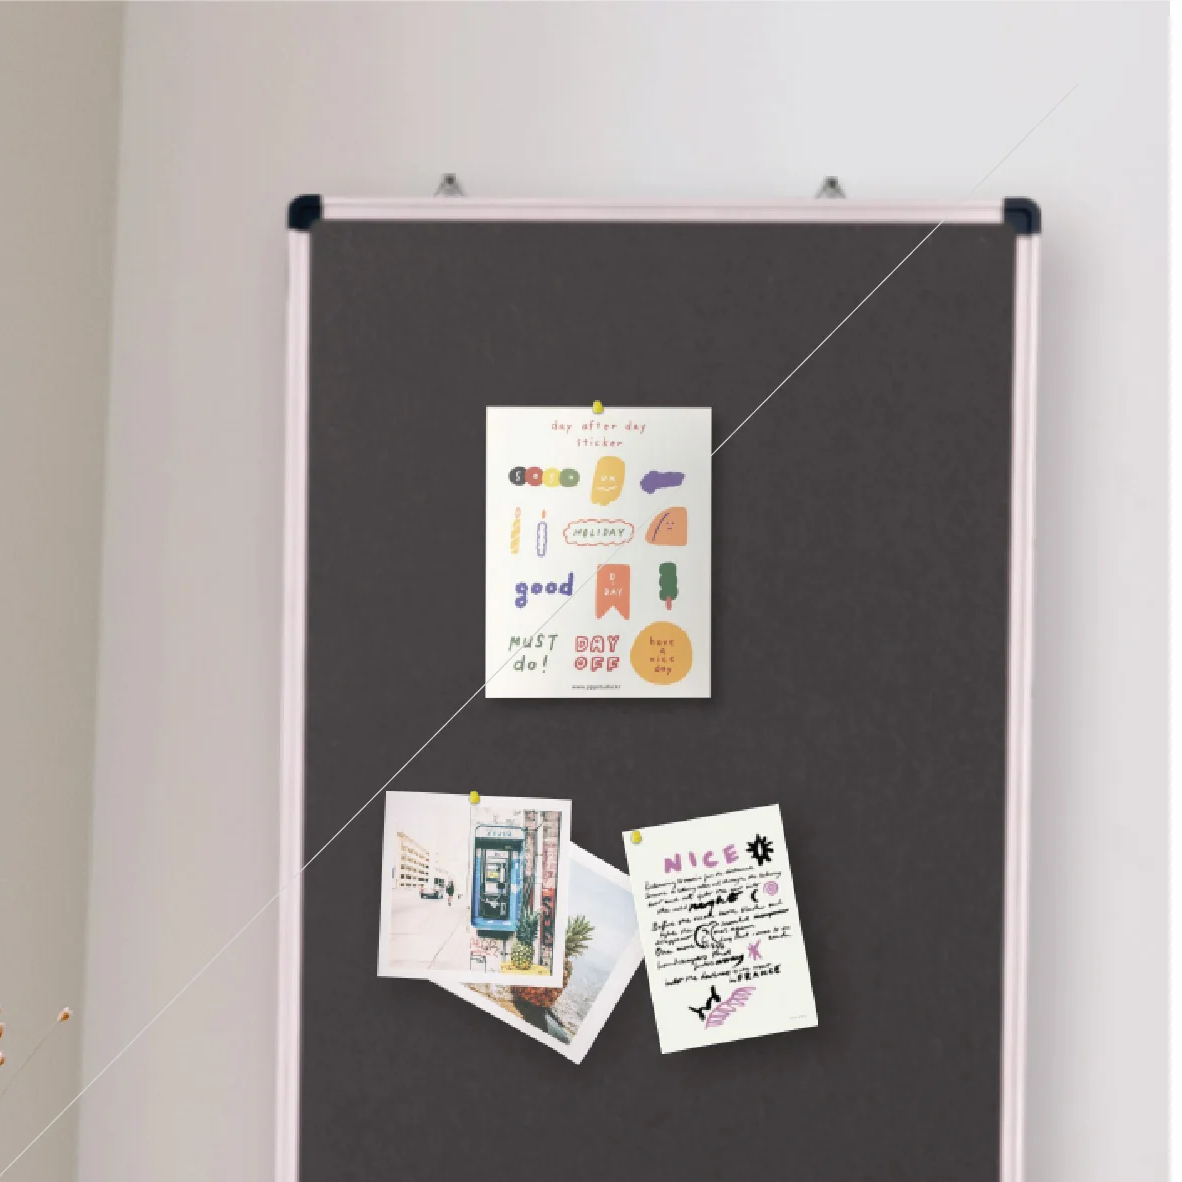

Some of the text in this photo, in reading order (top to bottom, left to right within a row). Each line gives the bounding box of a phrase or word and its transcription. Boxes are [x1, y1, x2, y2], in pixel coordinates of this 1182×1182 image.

[551, 420, 646, 434] day after day
[572, 528, 626, 538] HOLIDAY
[515, 571, 574, 608] good
[575, 635, 620, 652] DAY
[513, 654, 548, 673] do!
[575, 656, 620, 672] OFF
[664, 844, 739, 873] NICE
